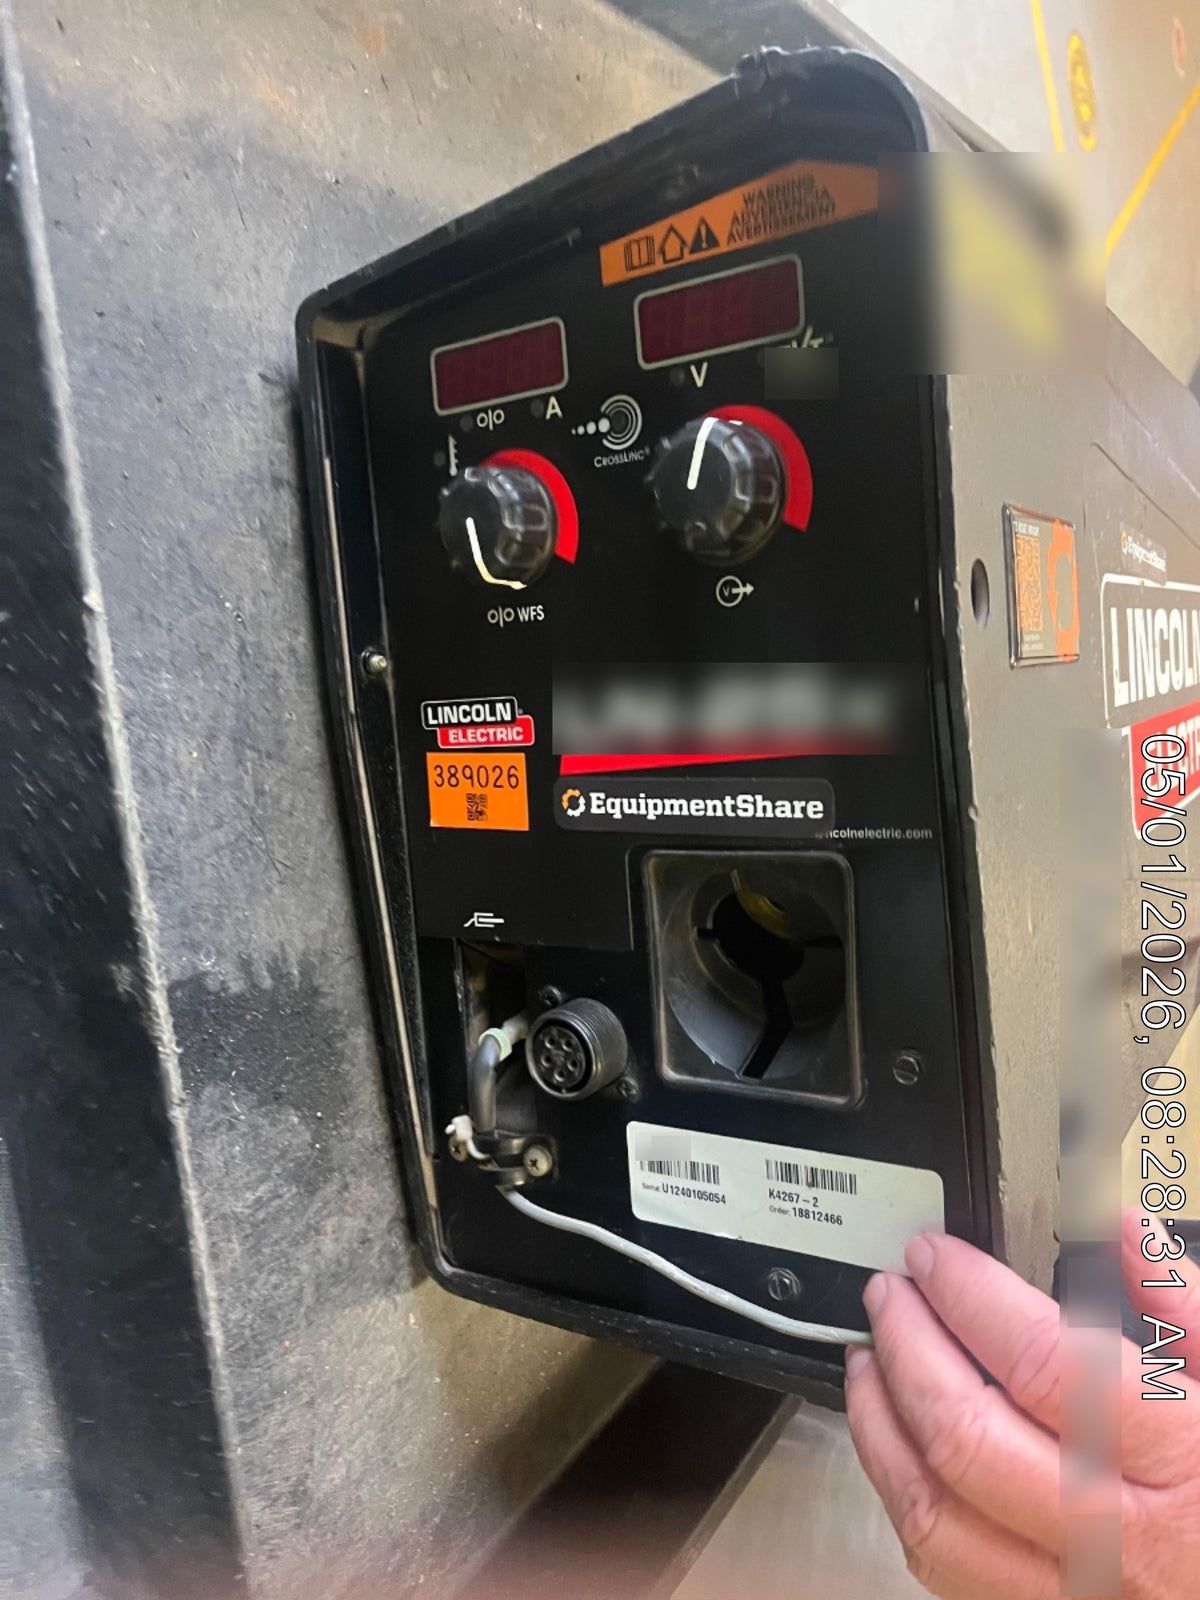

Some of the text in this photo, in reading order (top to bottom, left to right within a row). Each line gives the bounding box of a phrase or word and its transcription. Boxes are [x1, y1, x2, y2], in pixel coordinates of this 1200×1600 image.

[690, 361, 708, 388] V
[545, 395, 563, 420] A
[516, 604, 545, 623] WFS
[426, 702, 512, 725] LINCOLN
[448, 726, 524, 744] ELECTRIC
[433, 764, 520, 790] 389026
[589, 792, 825, 821] EquipmentShare
[661, 1182, 727, 1205] U1240105054
[792, 1206, 843, 1226] 18812466
